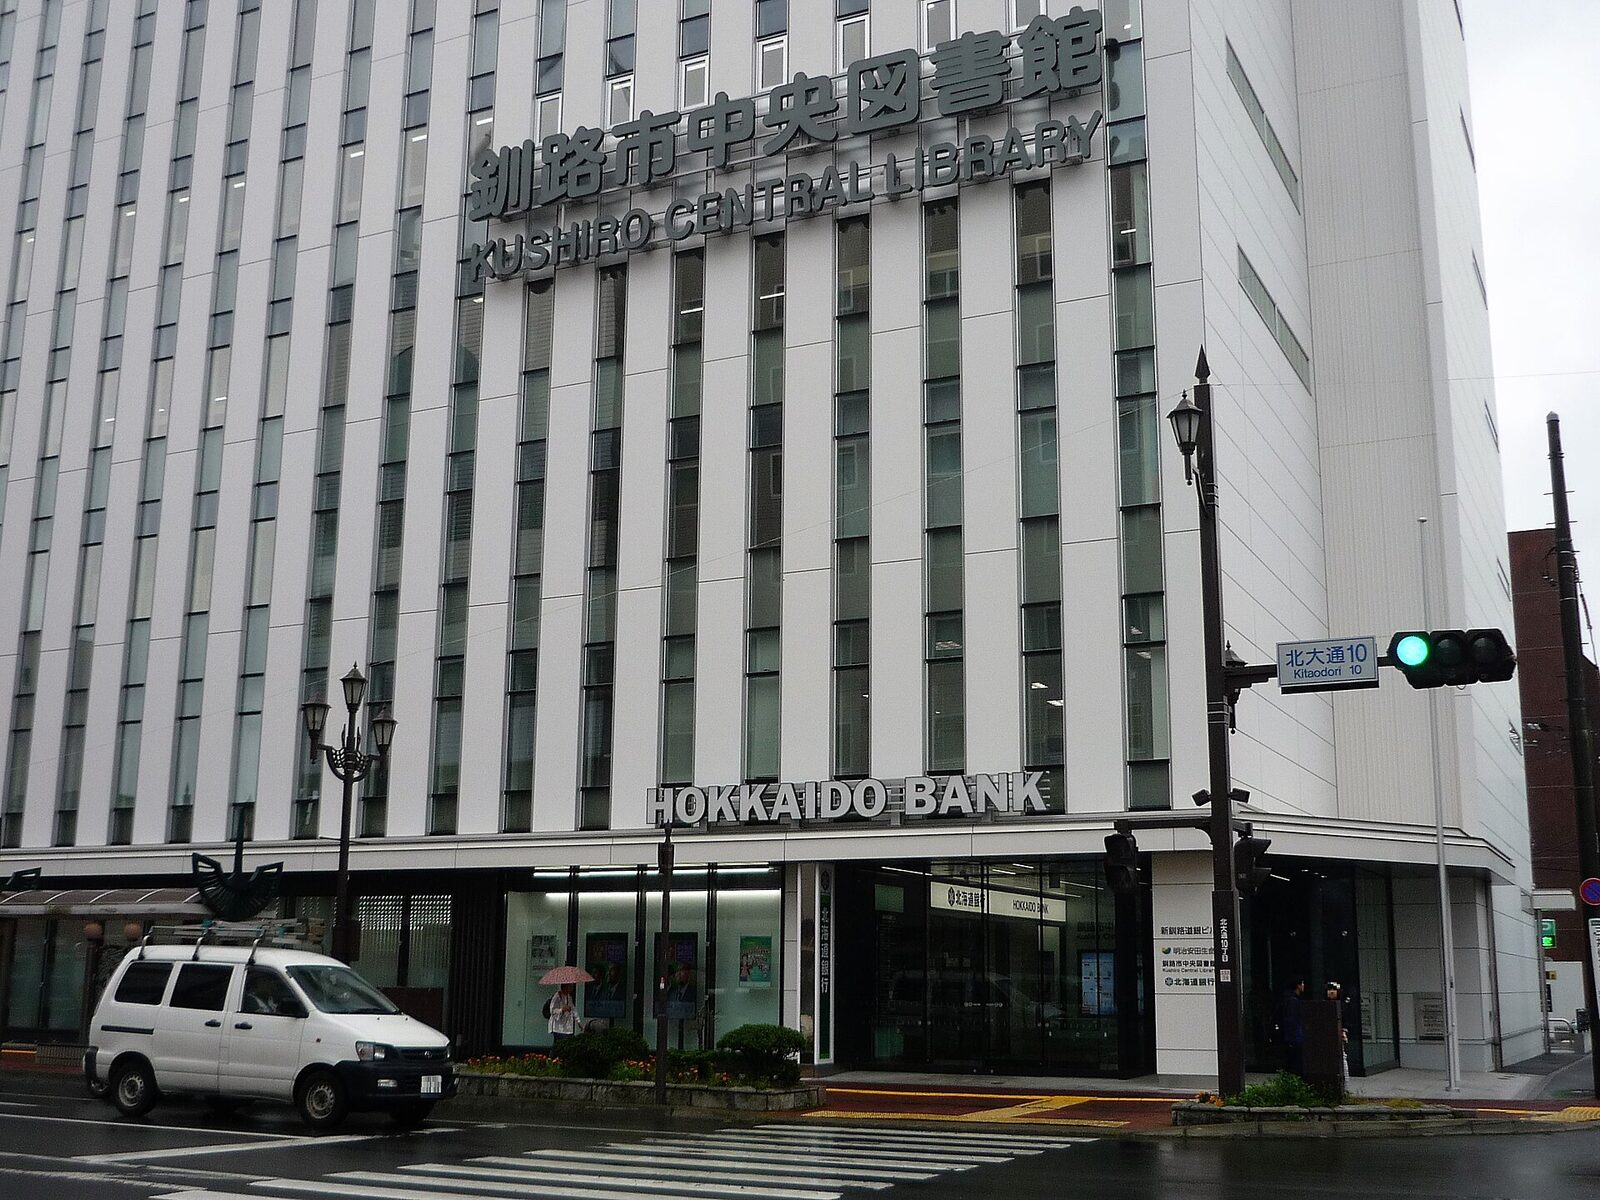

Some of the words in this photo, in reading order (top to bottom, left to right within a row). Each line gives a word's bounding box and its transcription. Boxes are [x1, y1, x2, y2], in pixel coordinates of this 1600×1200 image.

[469, 6, 1102, 222] 釧路市中央図書館
[470, 207, 653, 282] KUSHIRO
[664, 160, 875, 241] CENTRAL
[886, 110, 1102, 196] LIBRARY
[1286, 643, 1367, 668] 北大通10
[1293, 667, 1342, 679] Kitaodori
[1349, 664, 1362, 675] 10
[646, 778, 888, 824] HOKKAIDO
[904, 771, 1049, 816] BANK
[1012, 899, 1036, 913] HOKKAIDO
[1037, 902, 1049, 914] BNK
